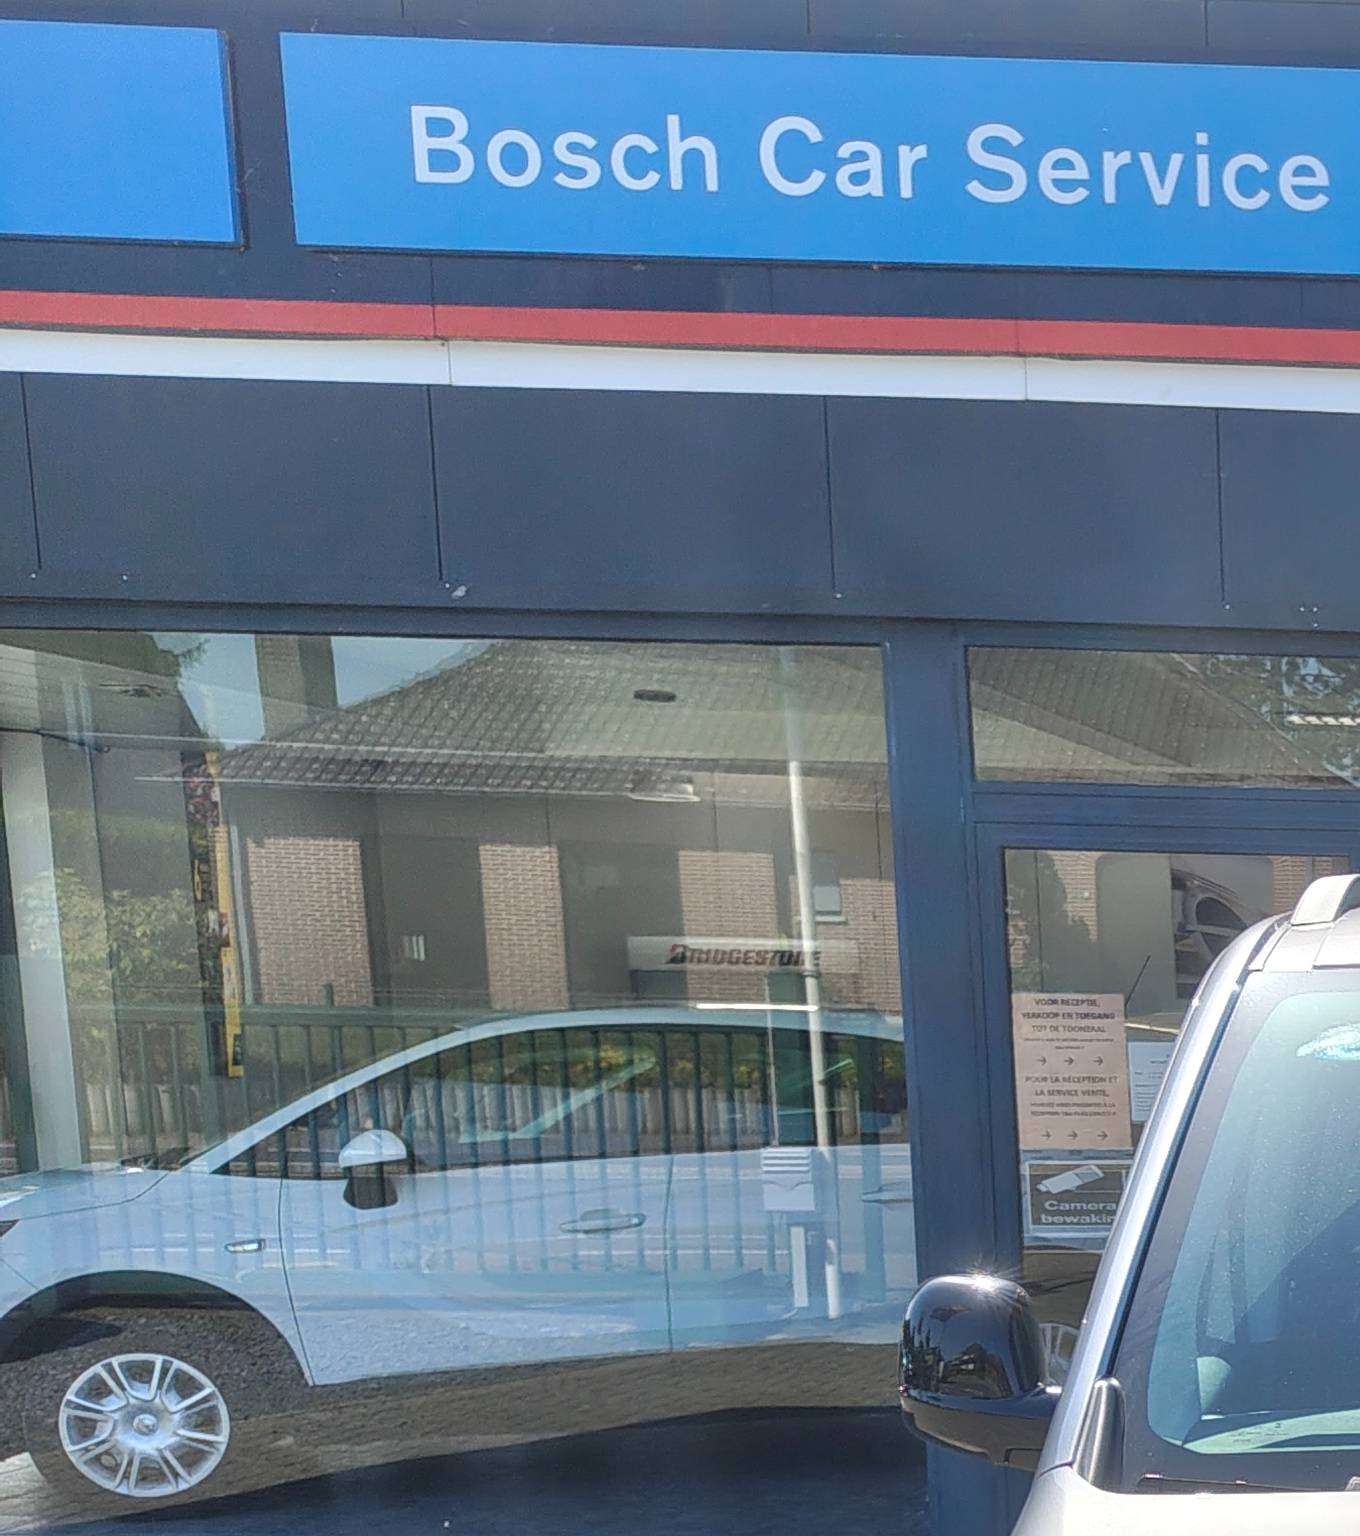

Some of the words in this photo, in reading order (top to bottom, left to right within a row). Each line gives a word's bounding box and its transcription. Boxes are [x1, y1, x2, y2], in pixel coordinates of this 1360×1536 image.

[410, 103, 718, 193] Bosch
[757, 113, 928, 200] Car
[964, 122, 1331, 213] Service
[1044, 1200, 1117, 1211] Camera
